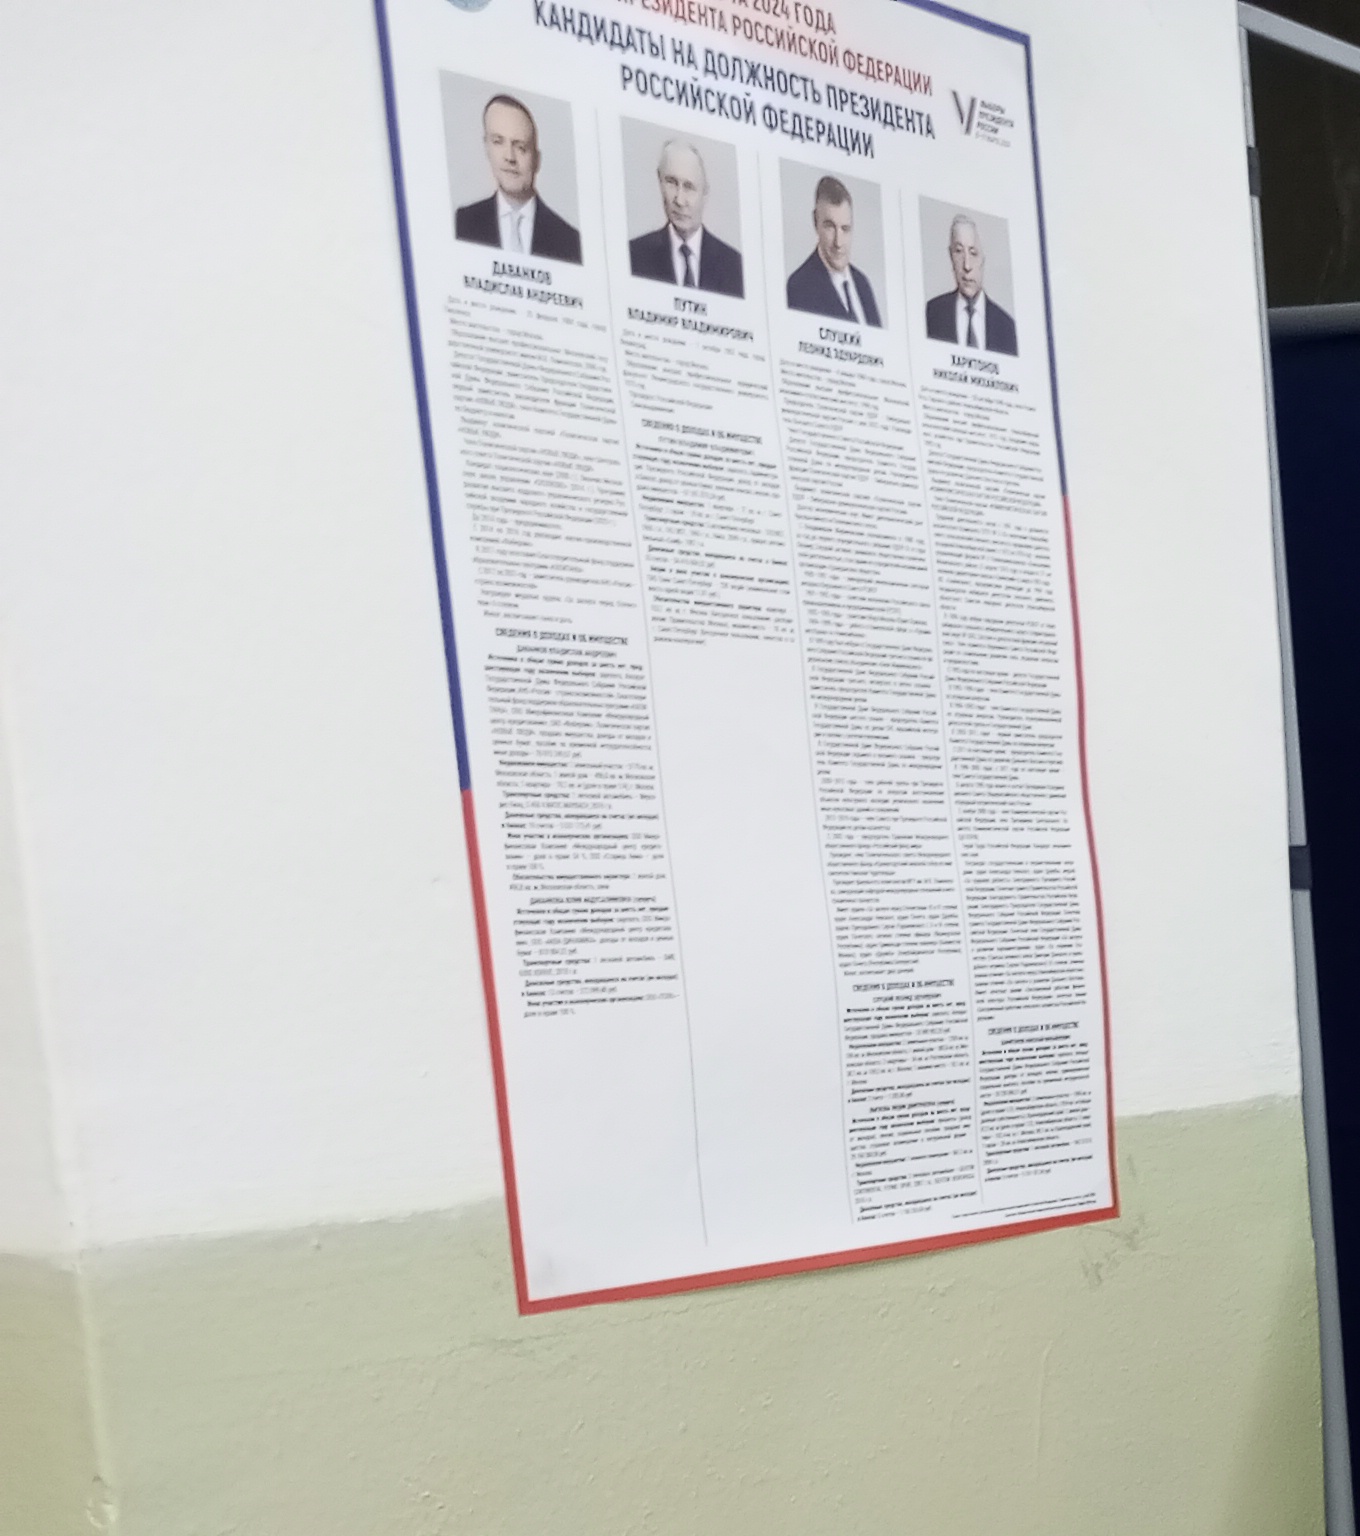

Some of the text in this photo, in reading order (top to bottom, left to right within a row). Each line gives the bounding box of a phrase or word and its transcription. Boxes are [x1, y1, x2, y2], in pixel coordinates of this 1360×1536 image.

[732, 15, 840, 66] РОССИЙСКОЙ
[842, 49, 933, 97] ФЕДЕРАЦИИ
[794, 2, 837, 34] ГОДА
[534, 0, 936, 140] КАНДИДАТЫ НА ДОЛЖНОСТЬ ПРЕЗИДЕНТА
[621, 64, 875, 159] РОССИЙСКОЙ ФЕДЕРАЦИИ
